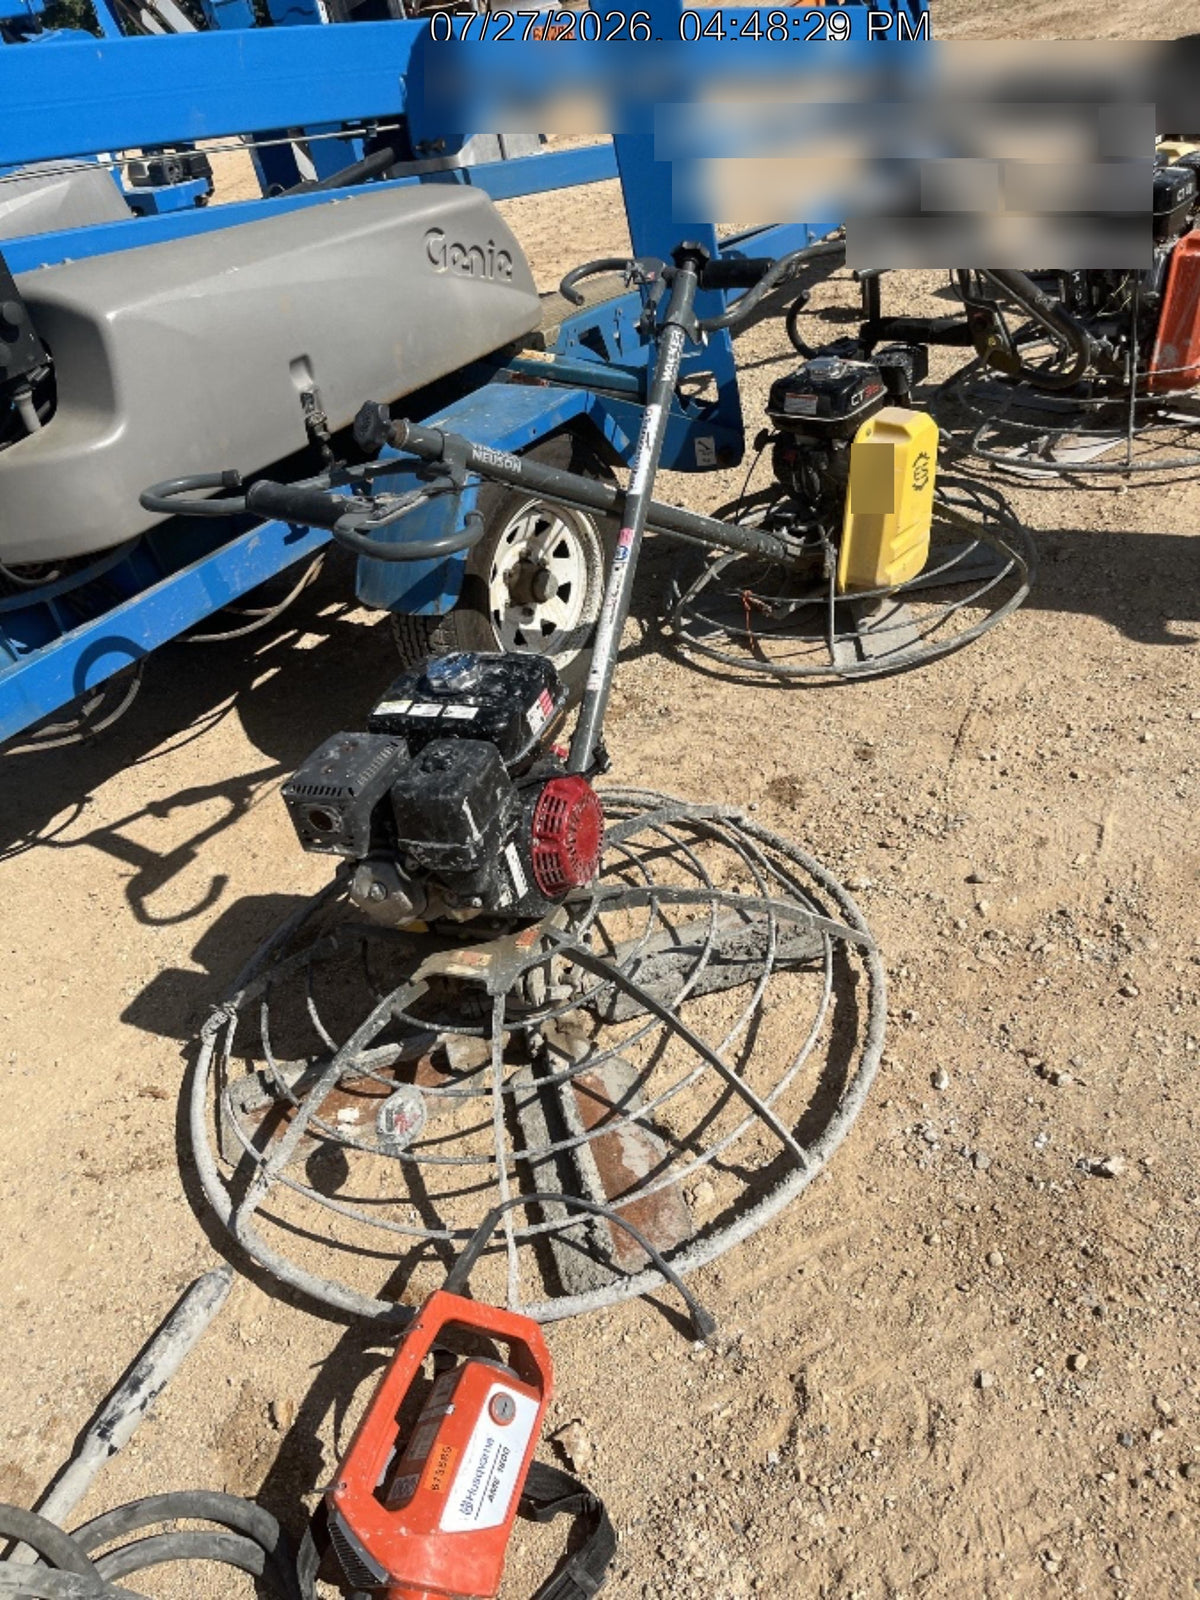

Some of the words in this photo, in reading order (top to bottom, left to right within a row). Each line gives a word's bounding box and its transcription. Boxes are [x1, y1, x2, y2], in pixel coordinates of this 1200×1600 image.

[424, 227, 513, 282] Genie
[472, 449, 522, 474] NEUSON
[465, 1437, 496, 1502] Husqvarna
